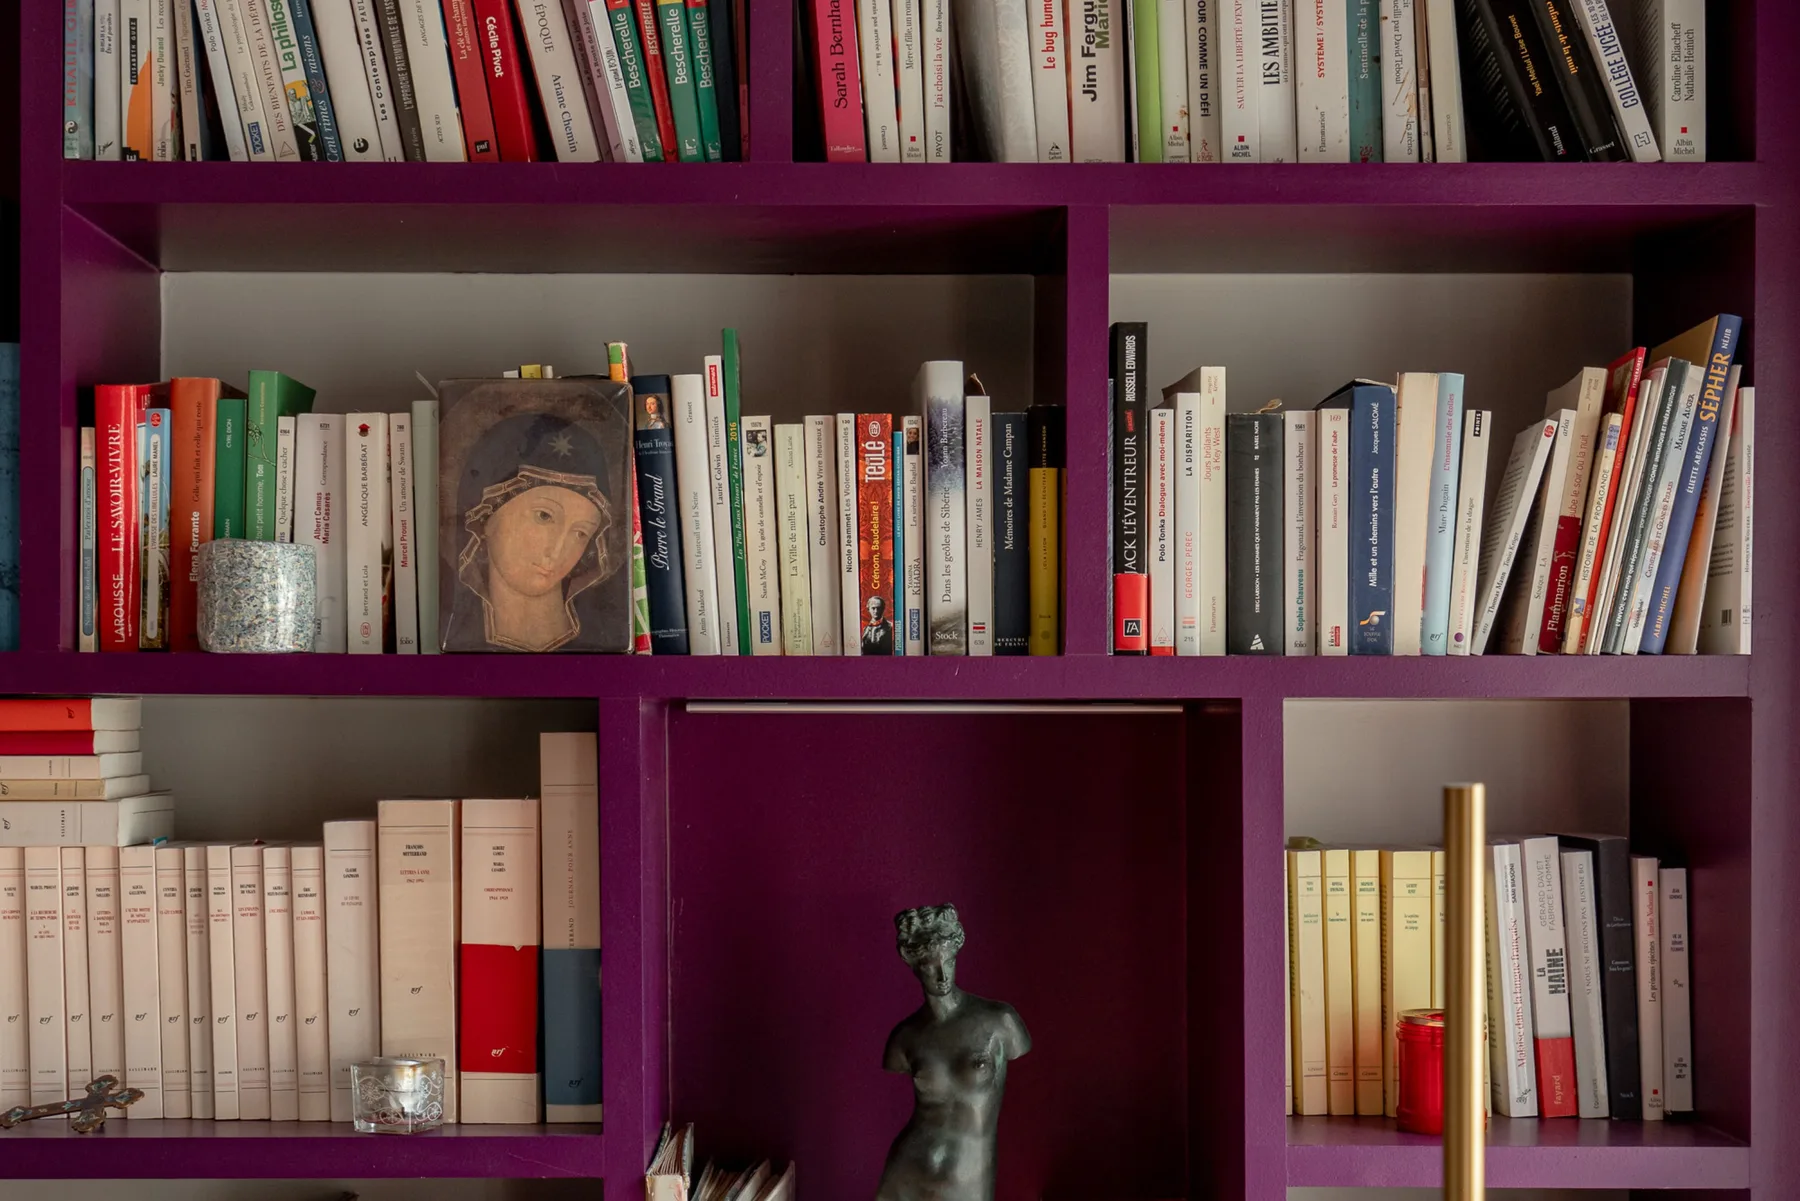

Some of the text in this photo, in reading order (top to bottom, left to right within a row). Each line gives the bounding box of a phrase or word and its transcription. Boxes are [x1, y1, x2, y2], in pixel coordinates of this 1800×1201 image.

[203, 13, 218, 52] Polo Tonka
[486, 16, 504, 77] Cécile Pivot
[533, 4, 555, 52] ÉPOQUE
[615, 13, 641, 88] Bescherelle
[642, 3, 658, 55] BESCHERELLE
[667, 9, 687, 84] Bescherelle
[693, 12, 712, 88] Bescherelle
[1041, 32, 1057, 69] Le bug
[156, 37, 166, 86] Jacky Durand
[182, 46, 191, 77] Guénard
[254, 27, 285, 132] DES BIENFAITS DE LA
[302, 35, 332, 131] rimes raisons
[363, 27, 387, 121] Les Contemplées
[391, 25, 414, 109] L'APPROCHE PATRIMONIALE
[832, 62, 848, 109] Sarah
[1082, 65, 1097, 102] Jim
[1198, 27, 1210, 117] COMME UN DÉFI
[1234, 27, 1244, 109] SAUVER LA LIBERTÉ
[1262, 61, 1280, 85] LES
[1594, 23, 1639, 108] COLLÈGE LYCÉE
[1671, 22, 1681, 102] Caroline Eliacheff
[1684, 29, 1695, 101] Nathalie Heinich
[552, 74, 577, 152] Ariane Chemin
[250, 122, 263, 154] POCKET
[935, 130, 943, 157] PAYOT
[1549, 126, 1564, 155] Balland
[1185, 409, 1193, 463] DISPARITION
[1371, 403, 1379, 429] SALOMÉ
[1674, 393, 1695, 451] MAXIME AUGER
[360, 443, 368, 480] BARBÉRAT
[711, 416, 724, 505] Laurie Colwin Intimités
[815, 428, 823, 458] heureux
[1122, 335, 1139, 574] JACK L'ÉVENTREUR RUSSELL EDWARDS
[1372, 431, 1380, 454] Jacques
[1439, 394, 1454, 534] Marc Dugain L'insomnie des étoiles
[976, 480, 982, 490] LA
[1003, 423, 1013, 550] Mémoires de Madame Campan
[1185, 466, 1193, 476] LA
[1369, 468, 1378, 493] l'autre
[1653, 352, 1731, 638] ALBIN MICHEL ÉLIETTE ABÉCASSIS SÉPHER
[360, 482, 368, 527] ANGÉLIQUE
[644, 473, 671, 570] Pierre le Grand
[818, 505, 826, 545] Christophe
[940, 408, 953, 602] Dans les geôles de Sibérie Yoann Barbereau
[1370, 495, 1378, 512] vers
[1581, 469, 1609, 580] HISTOIRE DE LA PROPAGANDE
[108, 423, 125, 642] LAROUSSE LE SAVOIR-VIVRE
[190, 511, 200, 581] Elena Ferrante
[314, 517, 322, 540] Albert
[400, 519, 408, 567] Marcel Proust
[787, 494, 797, 564] Ville de nulle part
[1369, 514, 1378, 544] chemins
[1370, 547, 1378, 557] un
[1185, 561, 1193, 598] GEORGES
[1296, 569, 1305, 631] Sophie Chauveau
[1369, 567, 1378, 586] Mille
[1547, 565, 1568, 632] Flammarion
[697, 589, 706, 636] Amin Maalouf
[1538, 890, 1547, 926] GÉRARD
[1544, 854, 1555, 931] FABRICE LHOMME
[411, 986, 422, 995] nrf
[1537, 967, 1546, 977] LA
[1546, 948, 1566, 994] HAINE
[491, 1047, 504, 1057] nrf
[1554, 1075, 1563, 1104] fayard
